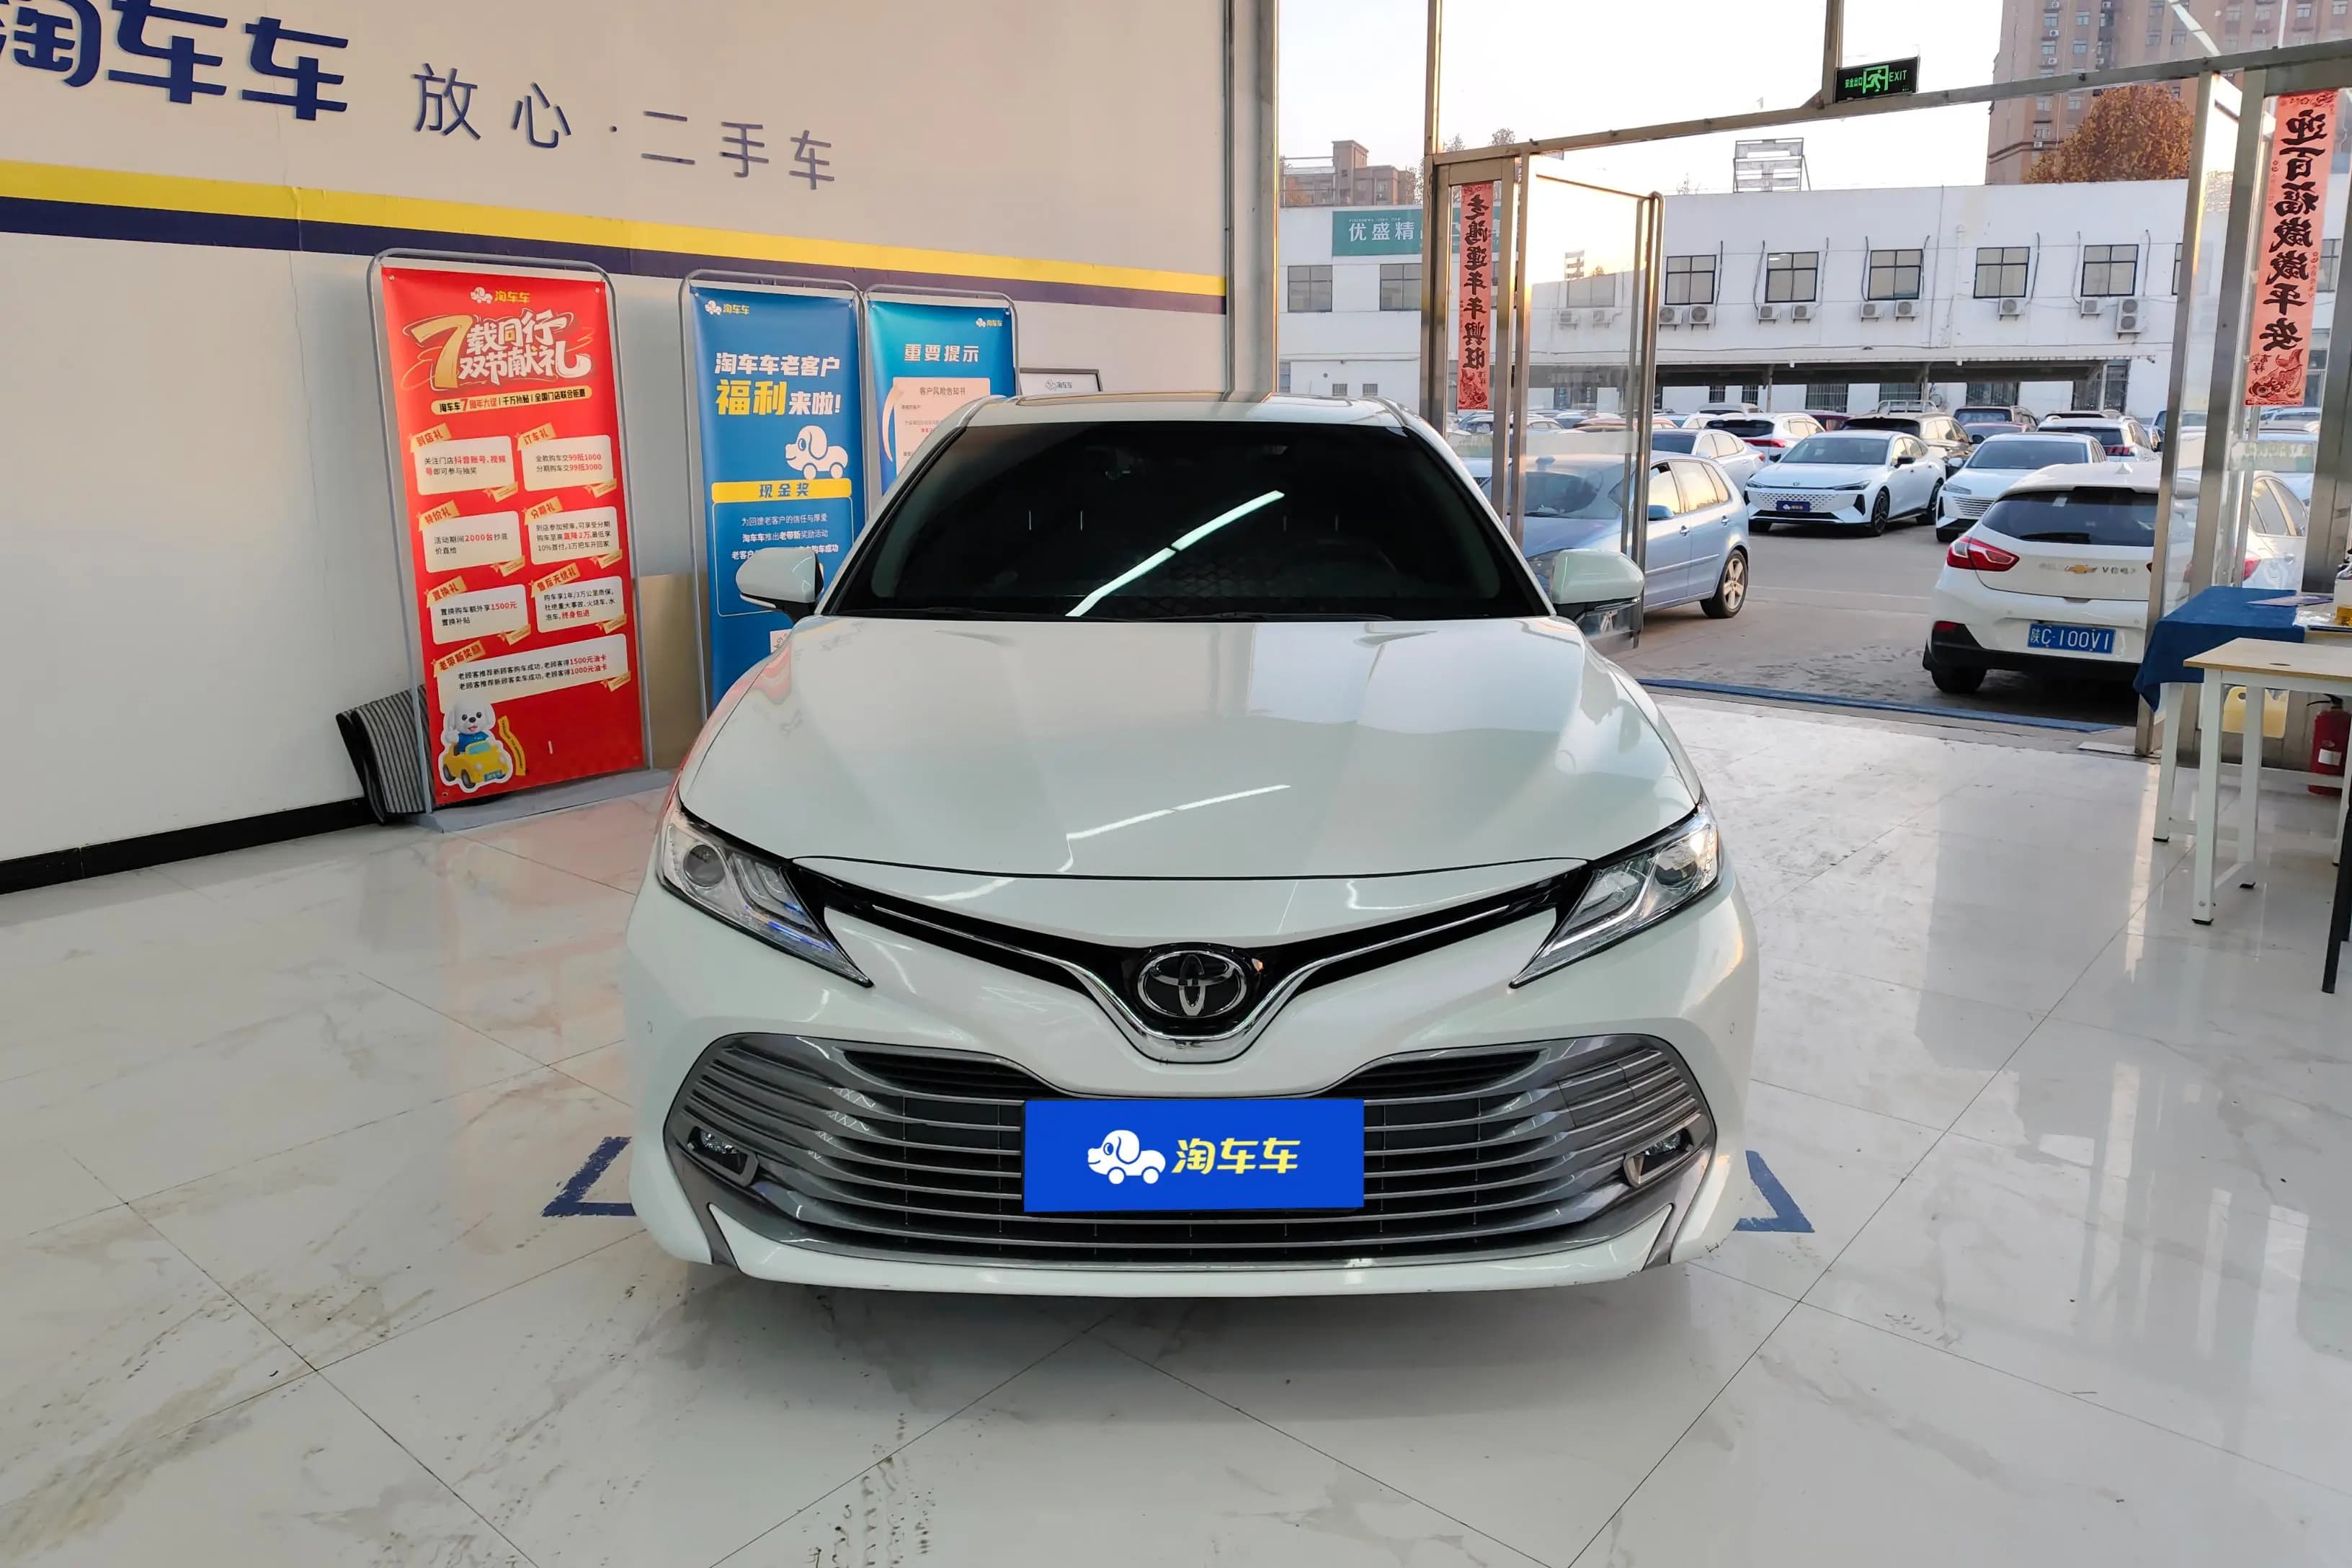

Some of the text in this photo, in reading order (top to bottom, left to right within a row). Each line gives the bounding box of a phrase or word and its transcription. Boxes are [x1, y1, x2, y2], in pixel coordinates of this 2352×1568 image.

[1845, 77, 1863, 88] 安全出口
[1889, 70, 1907, 82] EXIT
[1349, 221, 1422, 242] 优盛精
[494, 290, 530, 303] 淘车车
[723, 303, 749, 315] 淘车车
[904, 344, 979, 362] 重要提示
[458, 341, 592, 385] 双节献礼
[714, 352, 840, 377] 淘车车老客户
[919, 387, 966, 396] 客户风险告知书
[416, 429, 444, 447] 到店礼
[523, 428, 548, 445] 订车礼
[426, 467, 477, 476] 号即可参与抽奖
[759, 482, 810, 498] 现金奖
[424, 506, 451, 525] 特价礼
[530, 502, 556, 519] 分期礼
[432, 582, 459, 602] 置换礼
[441, 601, 517, 615] 置换购车额外享1500元
[442, 616, 471, 627] 置换补贴
